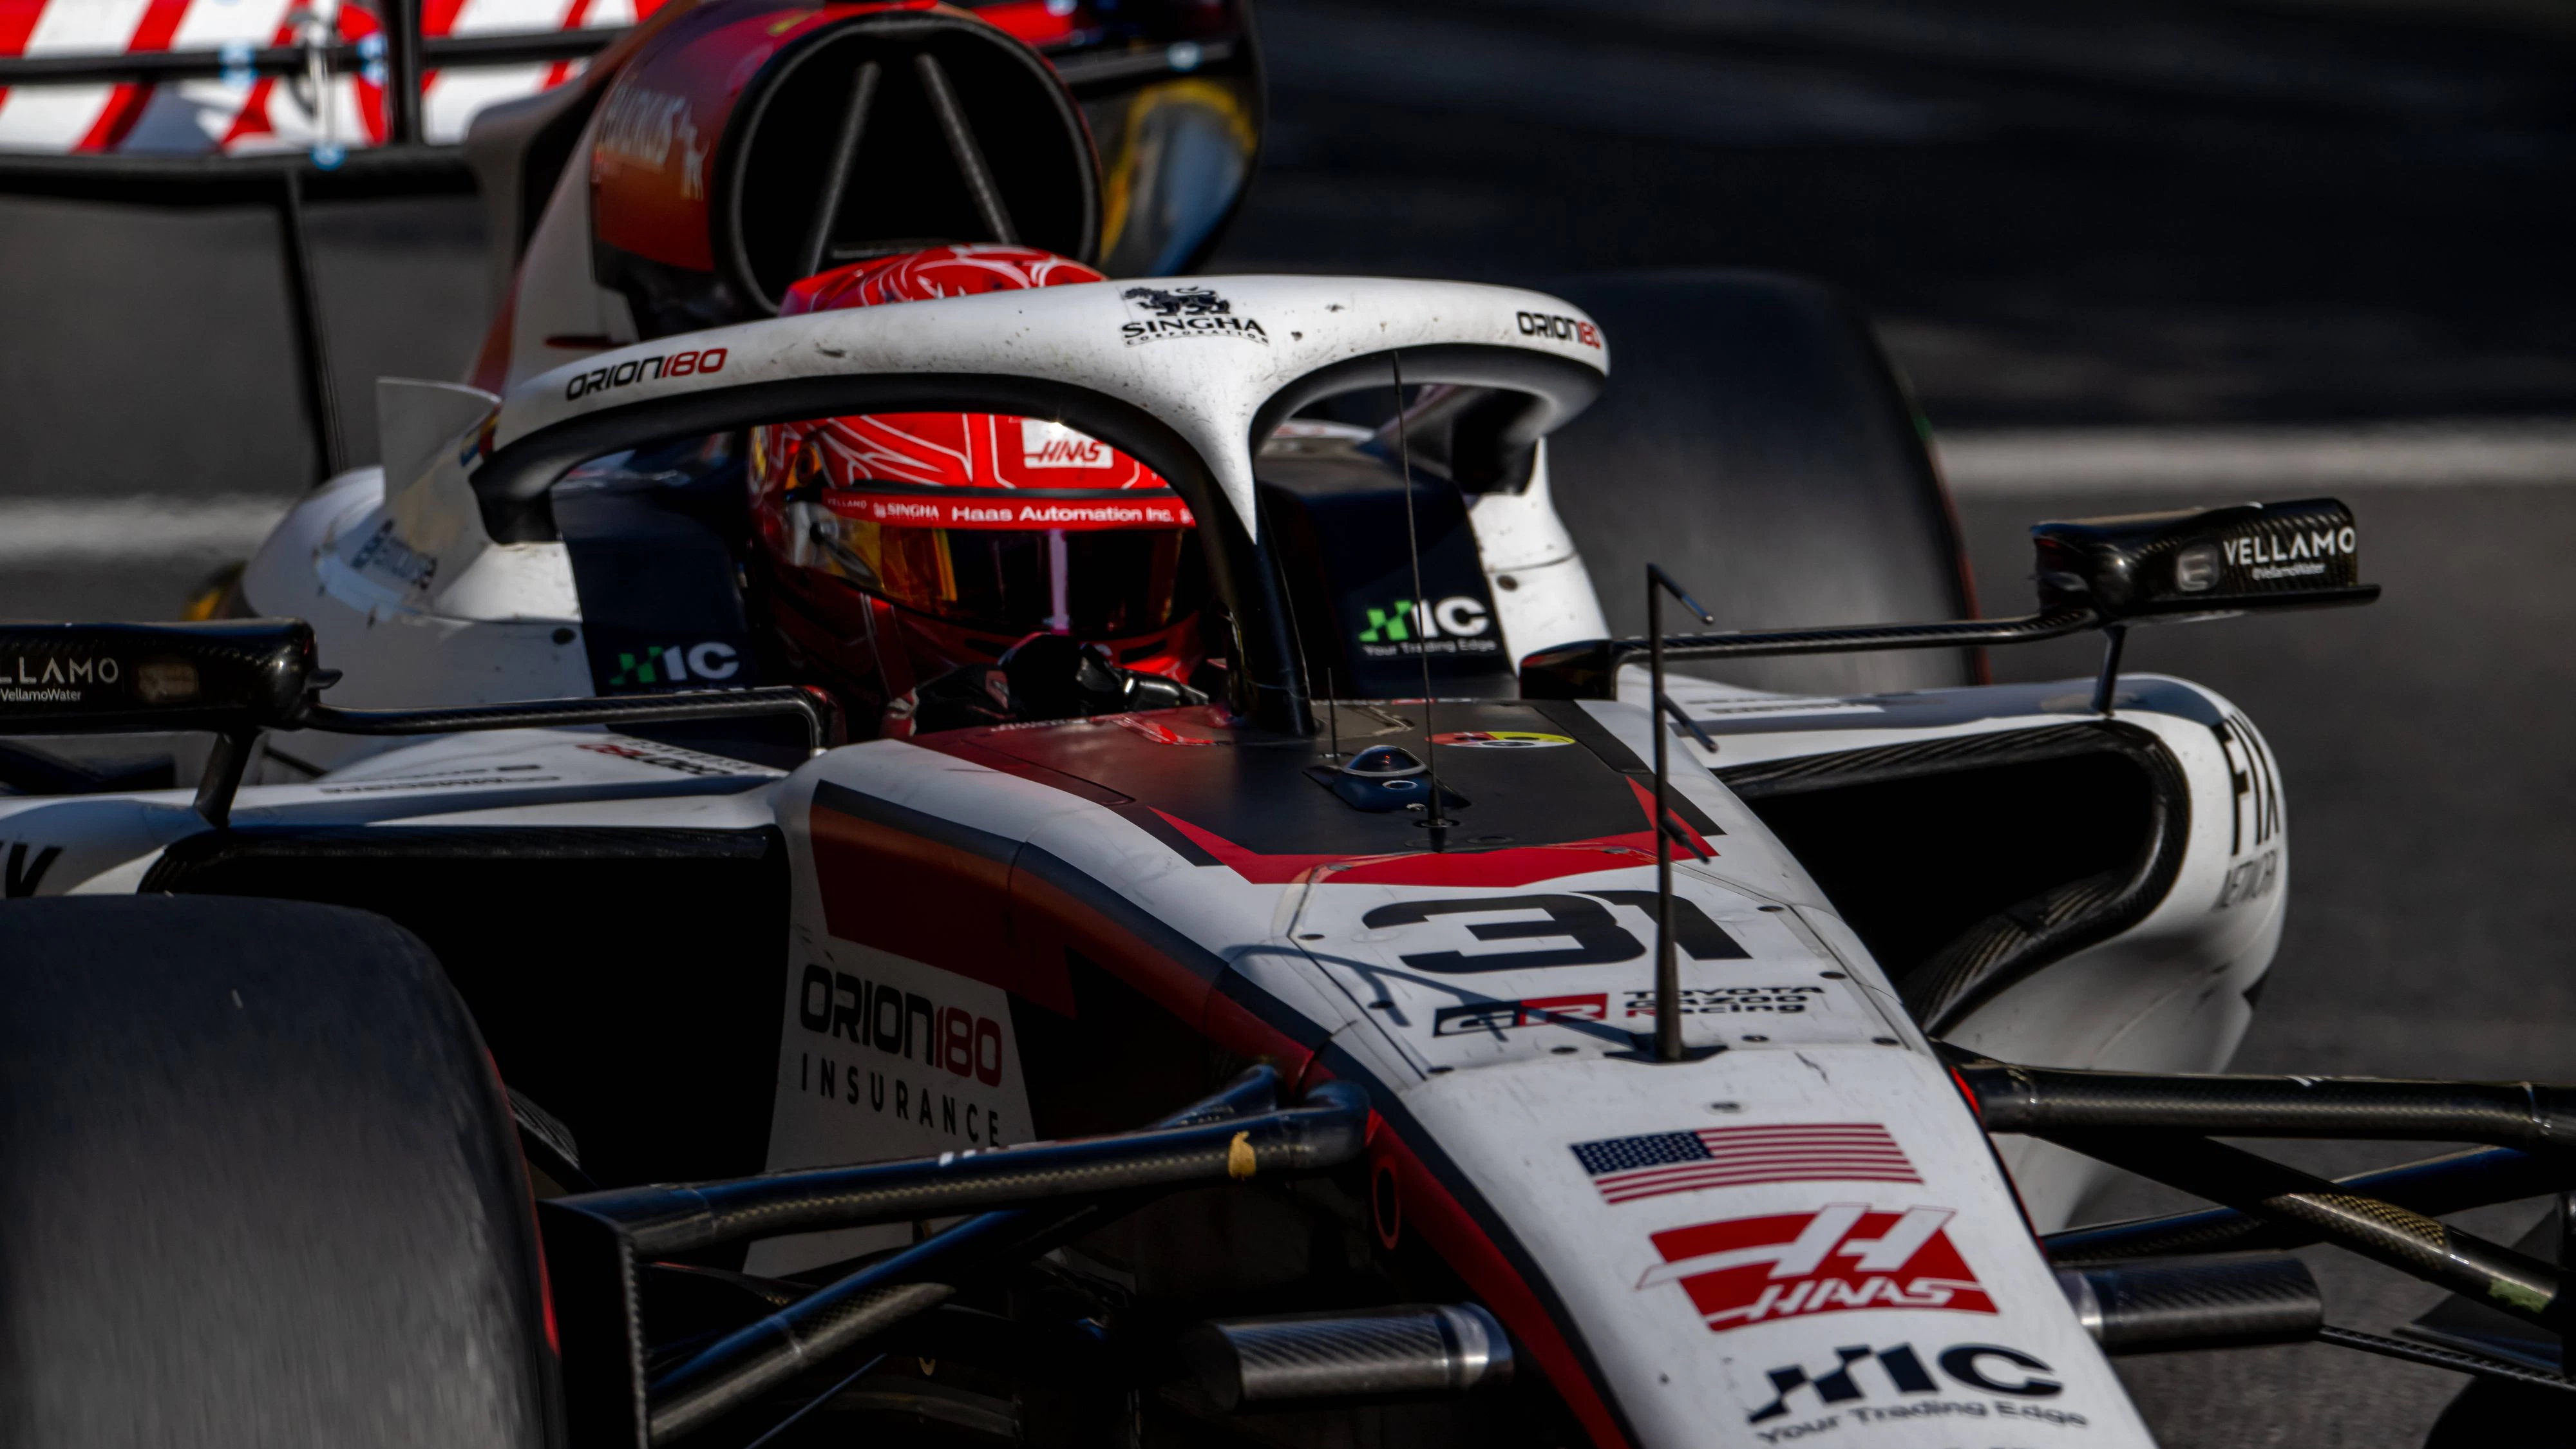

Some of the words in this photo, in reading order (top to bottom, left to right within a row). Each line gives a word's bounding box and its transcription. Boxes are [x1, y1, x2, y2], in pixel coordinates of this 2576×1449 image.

[1121, 317, 1267, 338] SINGHA
[1126, 330, 1269, 345] CORPORATION
[565, 348, 728, 401] ORION180
[1025, 440, 1106, 463] HAAS
[886, 502, 940, 518] SINGHA
[951, 506, 1013, 522] Haas
[1019, 506, 1143, 522] Automation
[1146, 506, 1174, 522] Inc.
[2223, 526, 2356, 566] VELLAMO
[1362, 644, 1397, 656] Your
[1399, 640, 1456, 653] Trading
[1457, 638, 1496, 652] Edge
[1361, 890, 1754, 974] 31
[800, 963, 1003, 1088] ORION180
[801, 1052, 1000, 1147] INSURANCE
[1713, 1277, 1974, 1321] HAAS
[1756, 1415, 1839, 1444] Your
[1847, 1400, 1988, 1424] Trading
[1995, 1400, 2090, 1428] Edge
